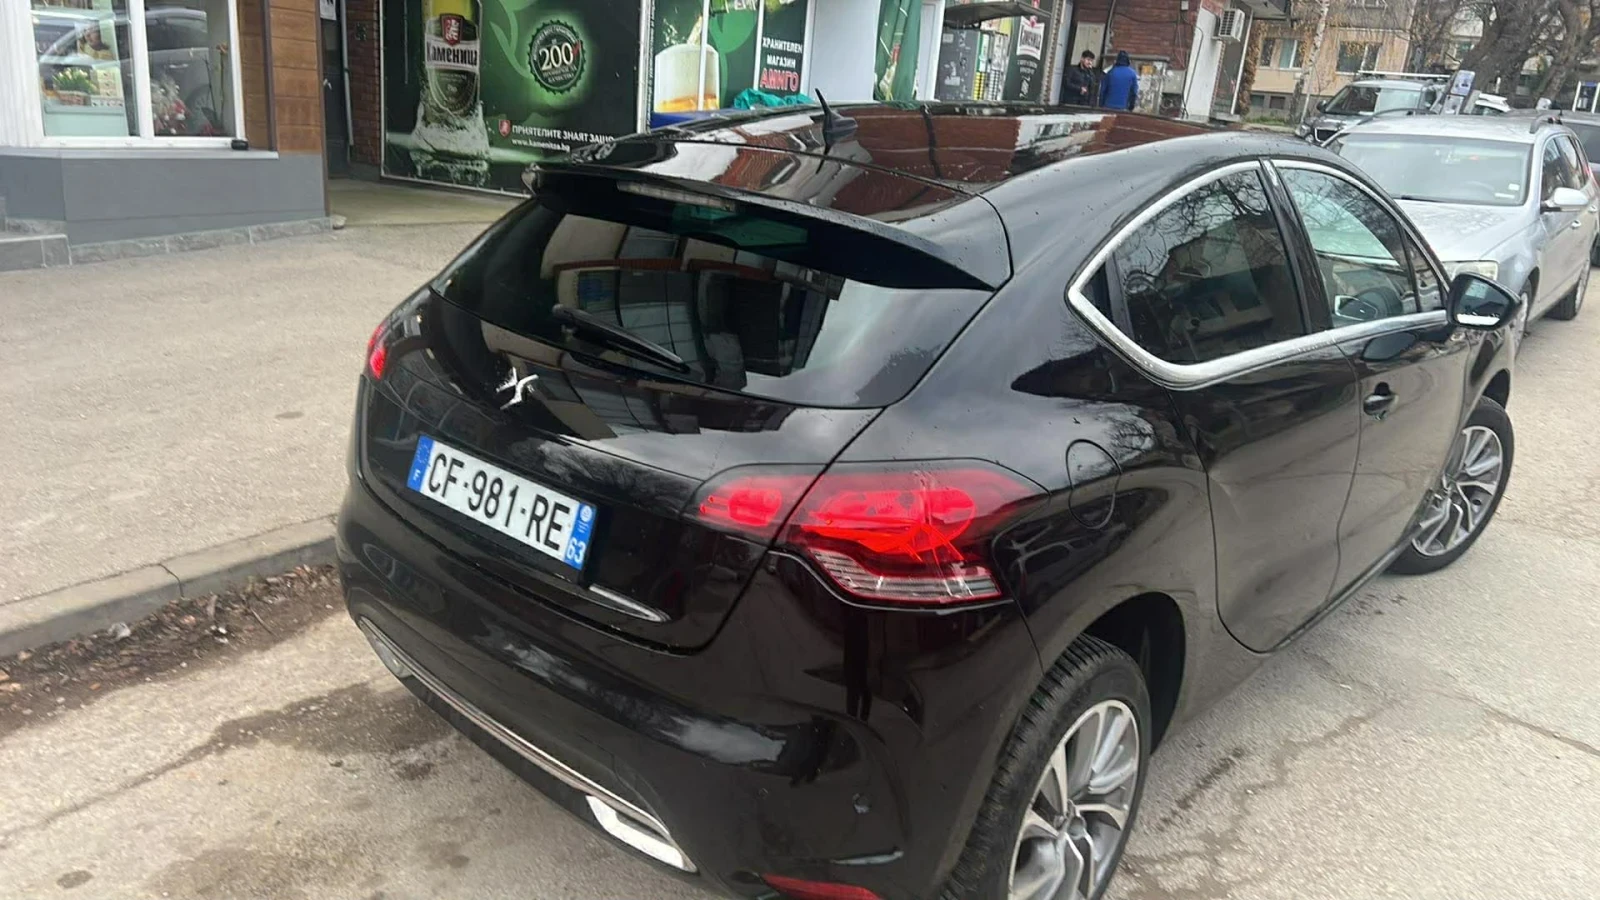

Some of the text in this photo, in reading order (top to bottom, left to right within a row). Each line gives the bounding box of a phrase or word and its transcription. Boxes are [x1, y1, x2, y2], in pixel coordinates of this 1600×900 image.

[539, 42, 573, 70] 200
[762, 37, 803, 53] ХРАНИТЕЛЕН
[766, 55, 796, 68] МАГАЗИН
[760, 67, 799, 92] АМИГО
[512, 125, 562, 139] ПРИЯТЕЛИТЕ
[562, 131, 588, 142] ЗНАЯТ
[428, 453, 570, 551] CF-981-RE
[567, 536, 586, 564] 63
